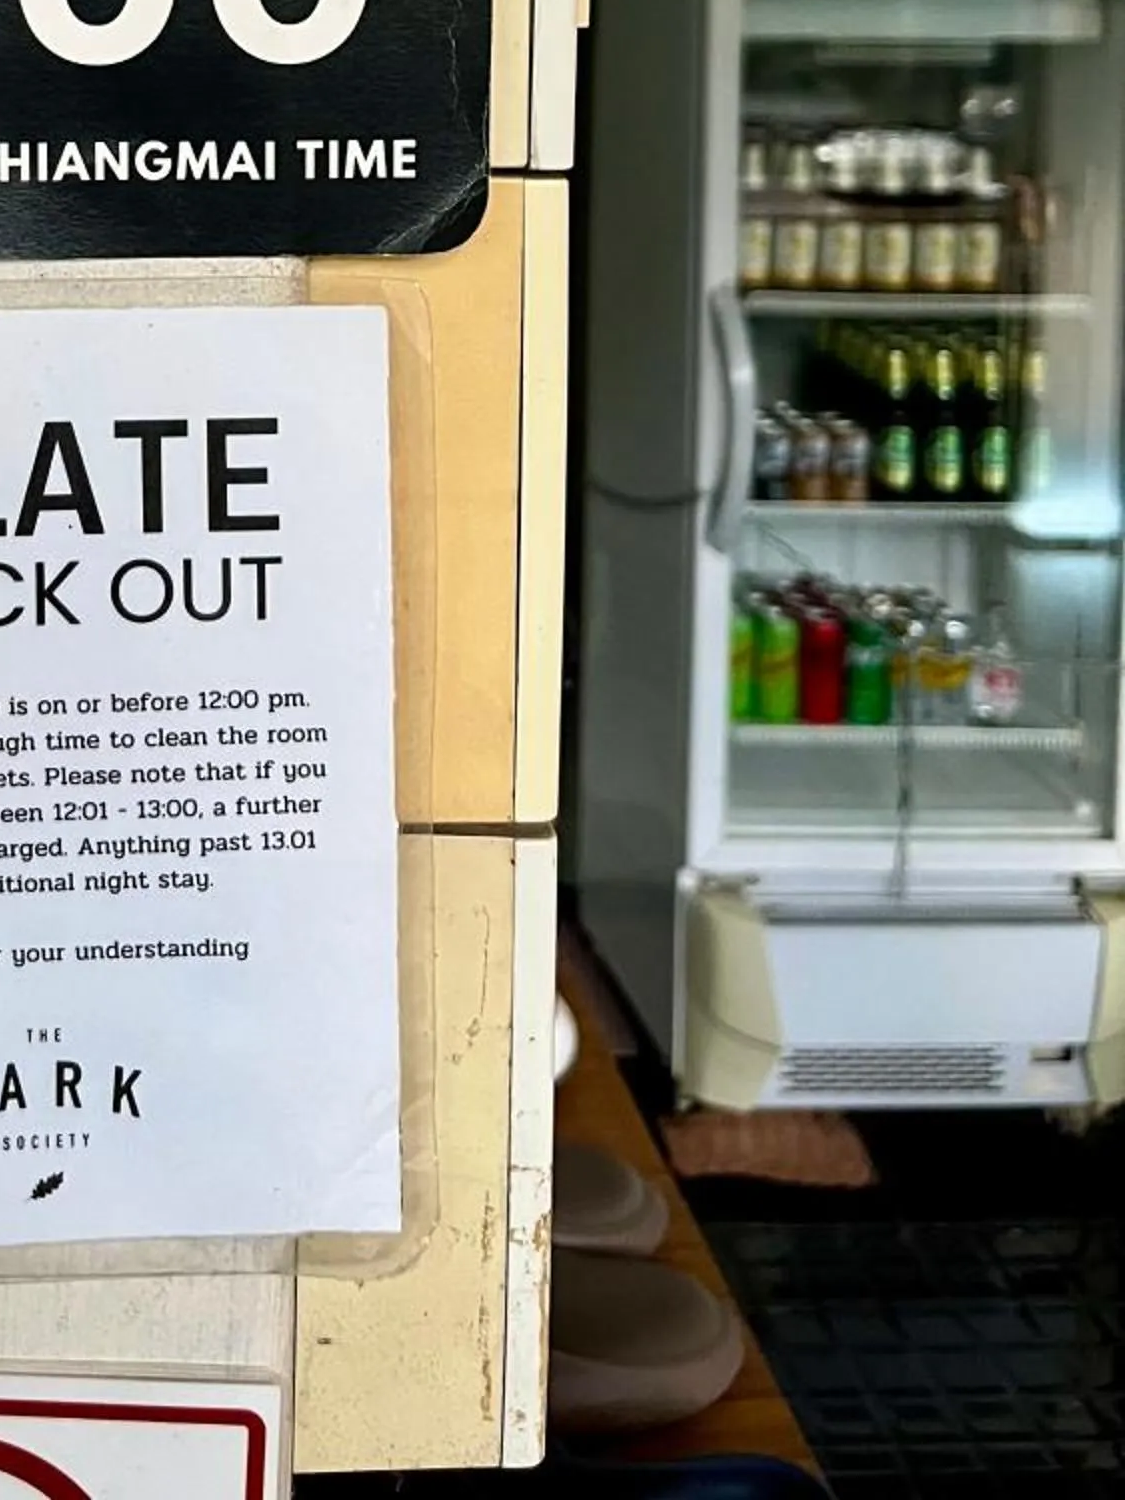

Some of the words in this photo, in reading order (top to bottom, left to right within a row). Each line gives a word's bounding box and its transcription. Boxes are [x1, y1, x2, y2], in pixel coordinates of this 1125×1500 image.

[296, 138, 417, 180] TIME
[110, 555, 283, 624] OUT
[8, 696, 28, 716] is
[37, 699, 68, 716] on
[76, 698, 102, 715] or
[110, 691, 189, 713] before
[198, 689, 260, 711] 12:00
[268, 692, 310, 713] pm.
[45, 731, 100, 751] time
[109, 731, 136, 749] to
[144, 727, 208, 748] clean
[217, 725, 258, 746] the
[267, 727, 328, 744] room
[44, 766, 122, 787] Please
[130, 765, 186, 784] note
[194, 761, 247, 782] that
[254, 759, 276, 780] if
[282, 763, 327, 784] you
[53, 801, 108, 822] 12:01
[136, 798, 204, 820] 13:00,
[212, 801, 227, 817] a
[235, 795, 322, 816] further
[77, 835, 191, 860] Anything
[200, 833, 252, 858] past
[260, 829, 316, 851] 13.01
[84, 870, 150, 895] night
[158, 870, 214, 893] stay.
[11, 947, 66, 968] your
[74, 938, 249, 962] understanding
[26, 1027, 61, 1044] THE
[2, 1132, 90, 1152] SOCIETY
